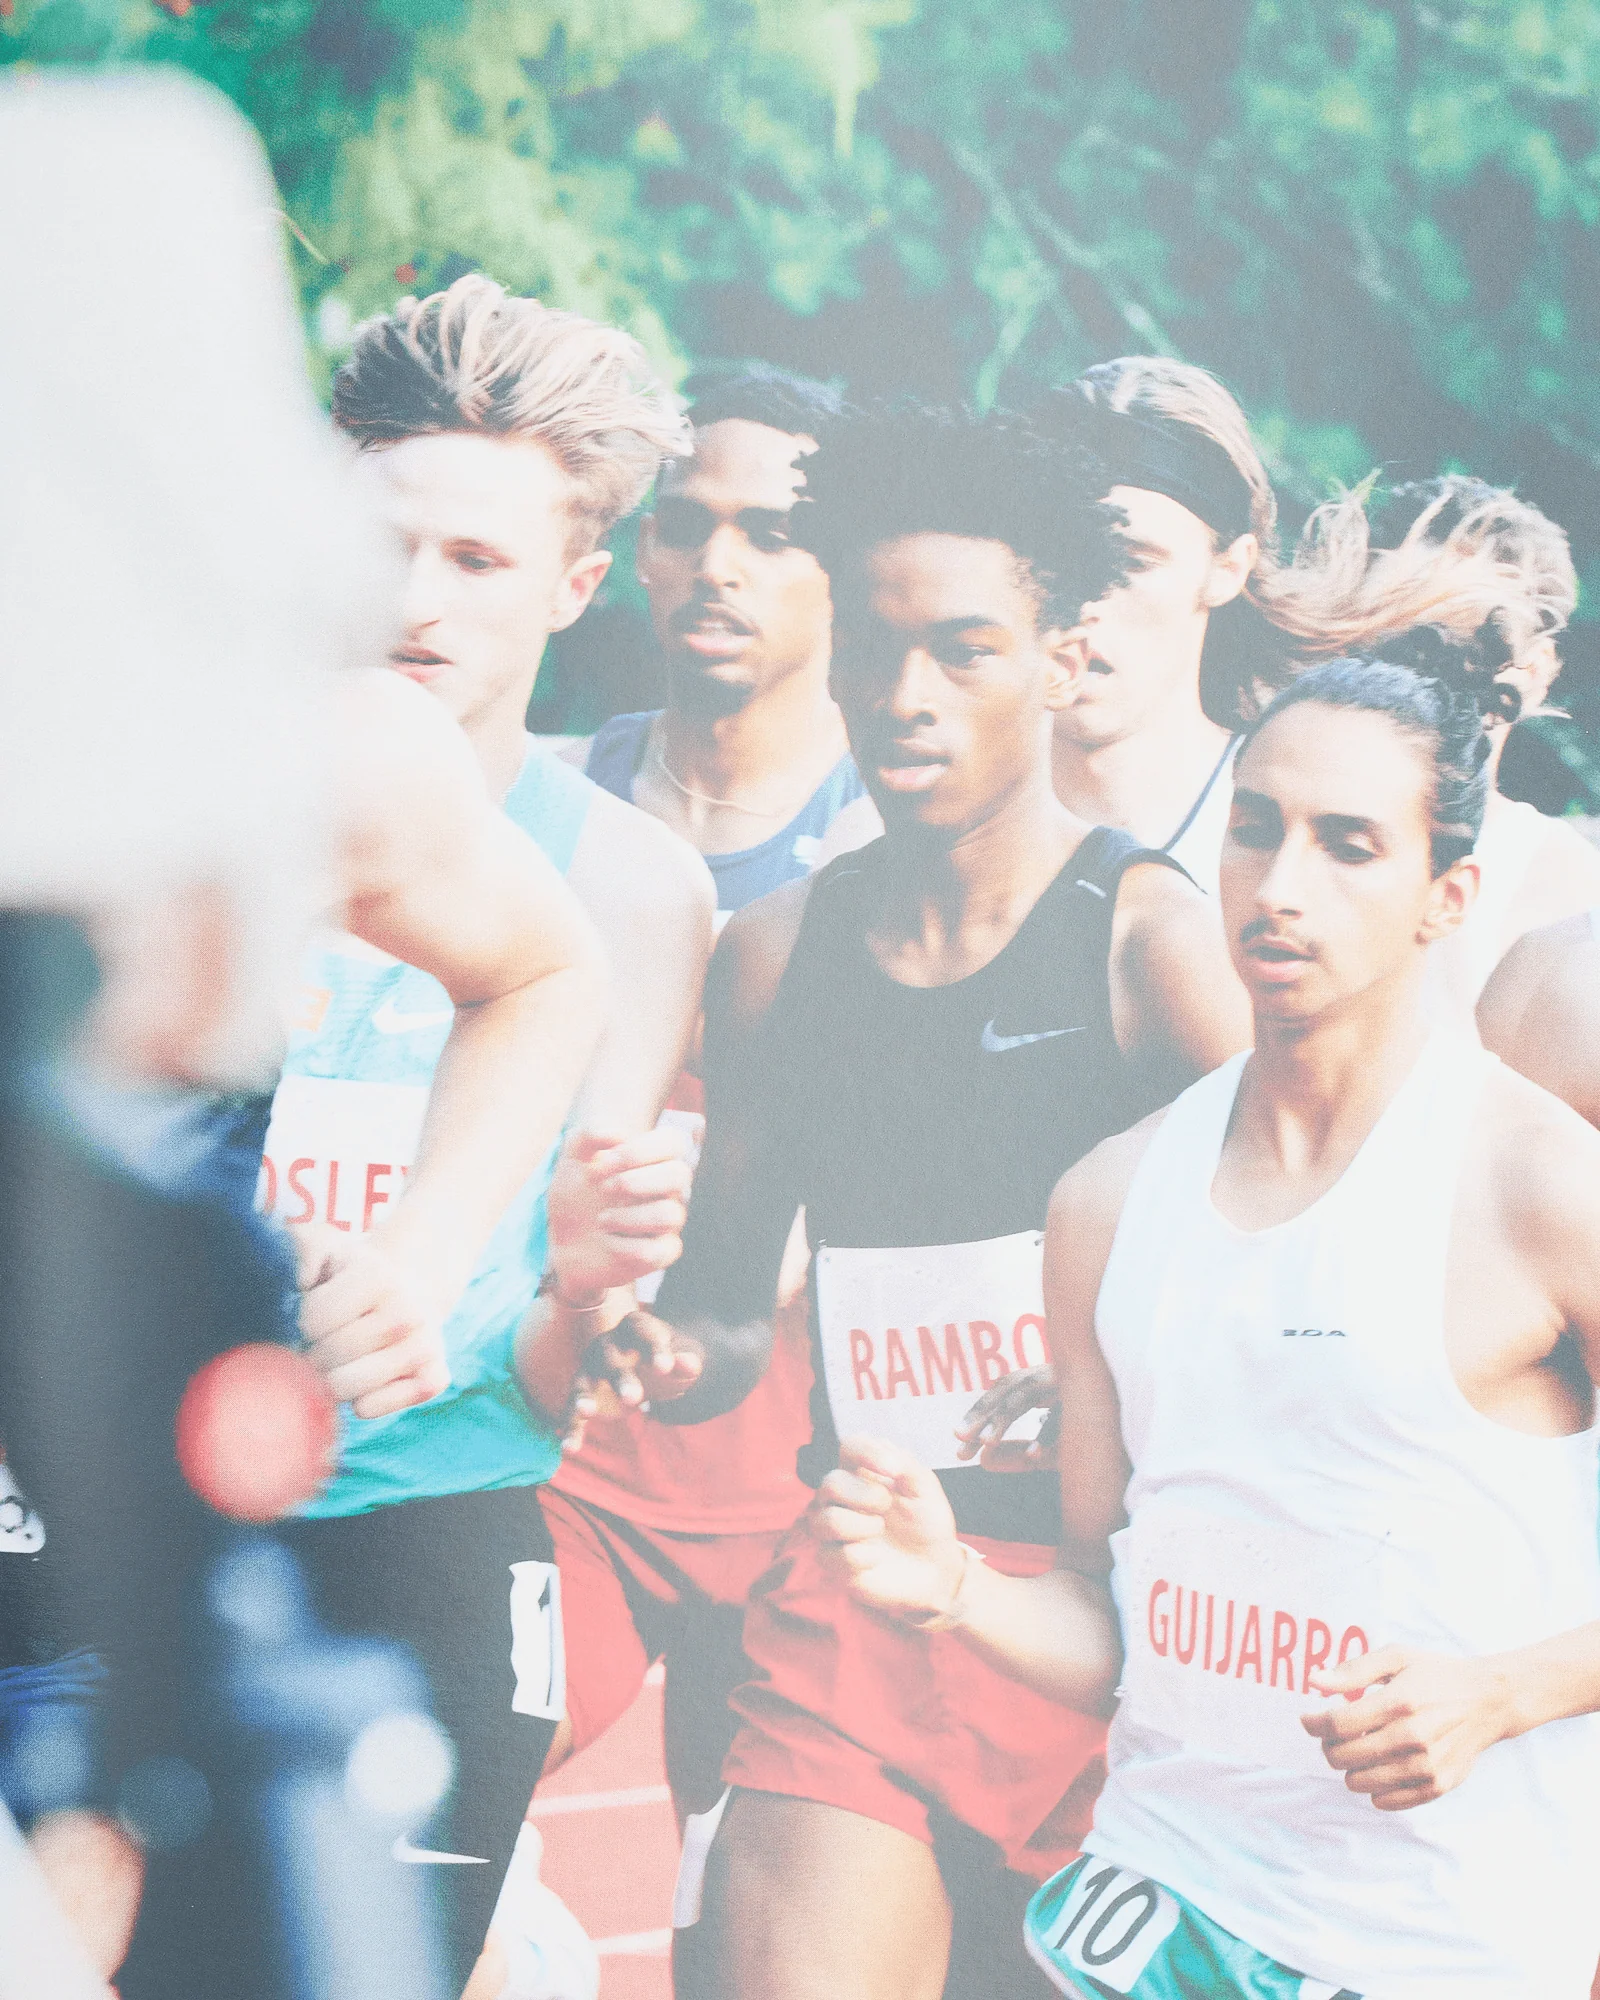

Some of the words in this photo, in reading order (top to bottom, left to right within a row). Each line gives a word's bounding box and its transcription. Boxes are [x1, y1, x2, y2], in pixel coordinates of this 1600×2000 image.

[849, 1313, 1051, 1401] RAMBO
[1148, 1578, 1369, 1702] GUIJARRO
[1054, 1865, 1159, 1966] 10
